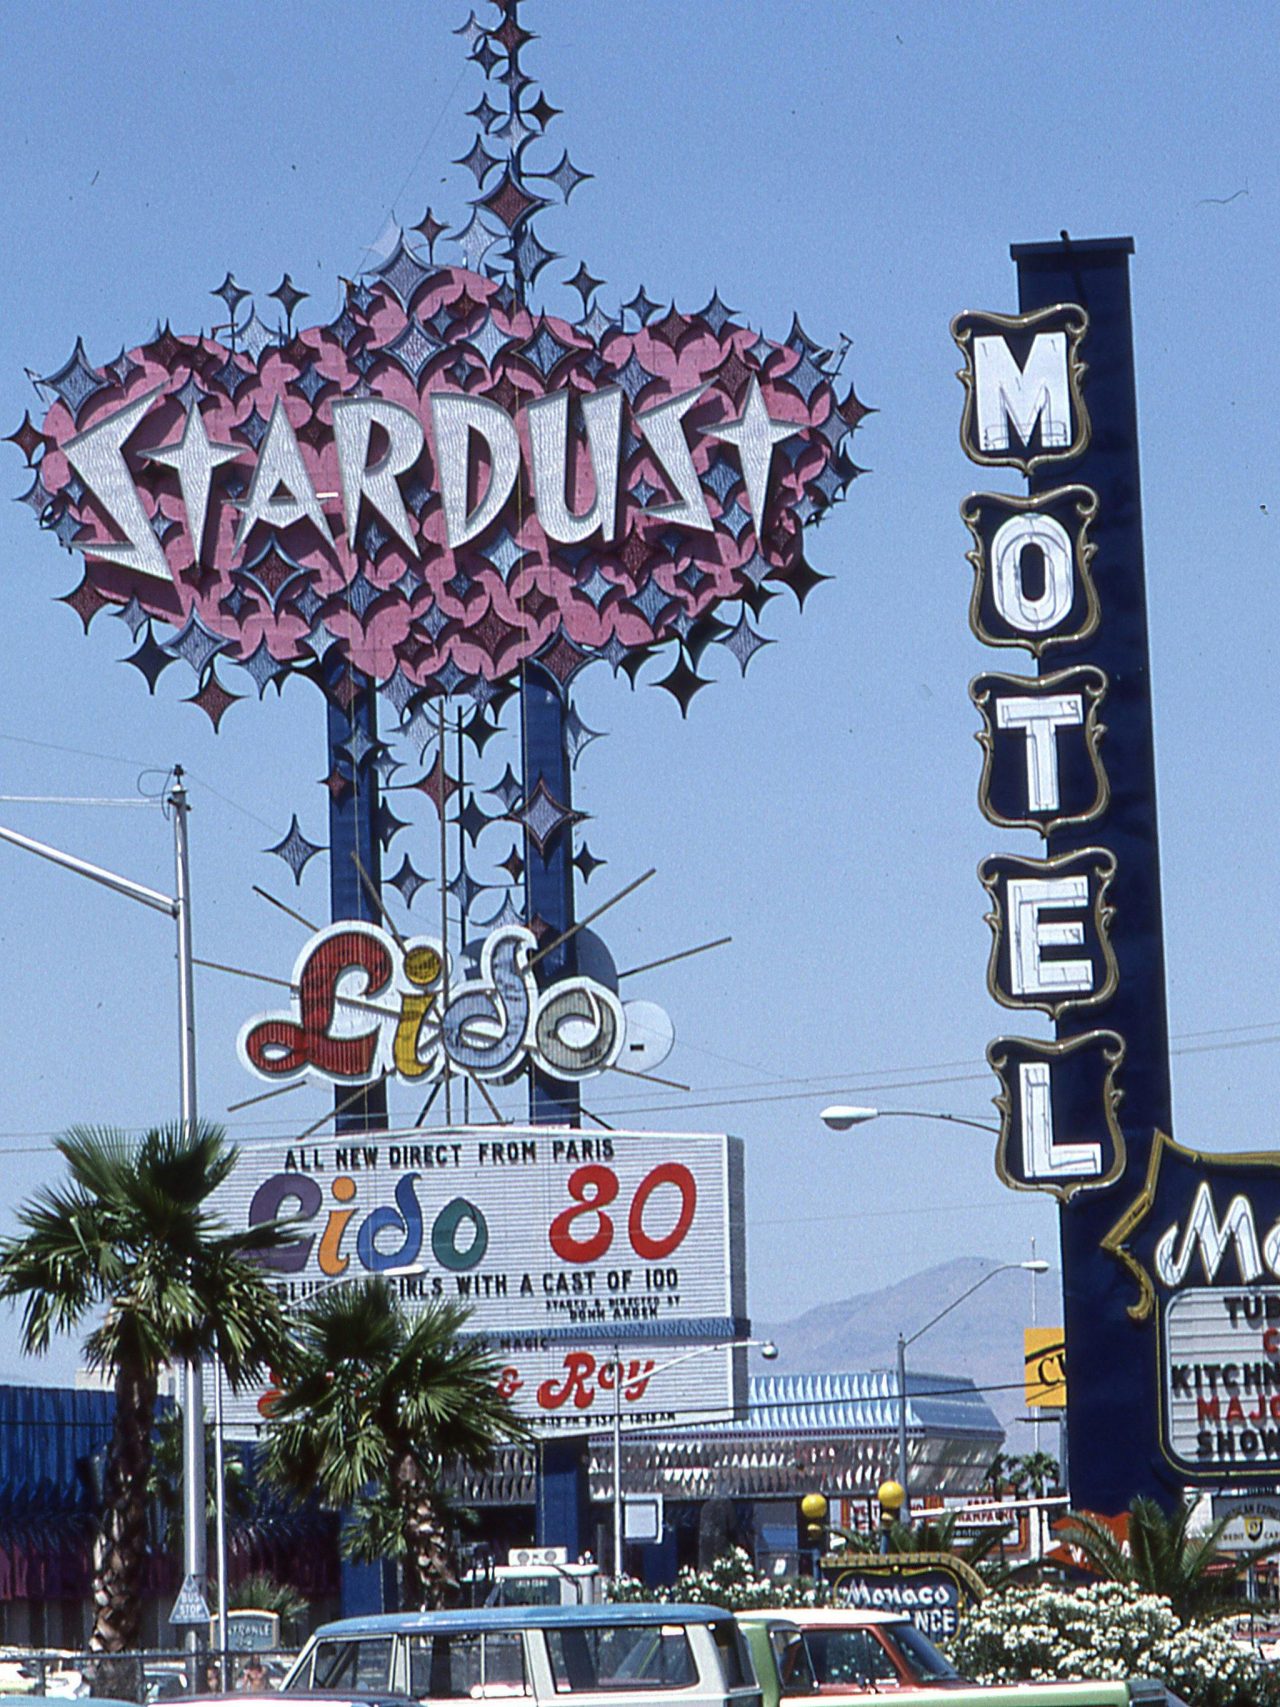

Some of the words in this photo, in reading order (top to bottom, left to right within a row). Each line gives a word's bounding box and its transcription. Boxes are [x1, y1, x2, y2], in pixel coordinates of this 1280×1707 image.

[60, 368, 808, 584] STARDUST
[973, 332, 1101, 1177] MOTEL
[240, 924, 622, 1082] Lido
[283, 1147, 324, 1171] ALL
[335, 1145, 378, 1169] NEW
[389, 1143, 461, 1168] DIRECT
[478, 1141, 537, 1165] FROM
[552, 1138, 615, 1162] PARIS
[548, 1161, 698, 1264] 80
[456, 1274, 507, 1297] WITH
[520, 1273, 534, 1296] A
[543, 1271, 597, 1293] CAST
[607, 1270, 632, 1291] OF
[645, 1268, 678, 1290] 100
[546, 1299, 588, 1311] STAGED
[608, 1296, 660, 1306] DIRECTED
[667, 1295, 681, 1305] BY
[569, 1308, 606, 1321] DONN
[613, 1307, 658, 1320] ARDEN
[496, 1366, 524, 1398] &
[536, 1351, 656, 1410] Roy
[179, 1604, 203, 1616] STOP
